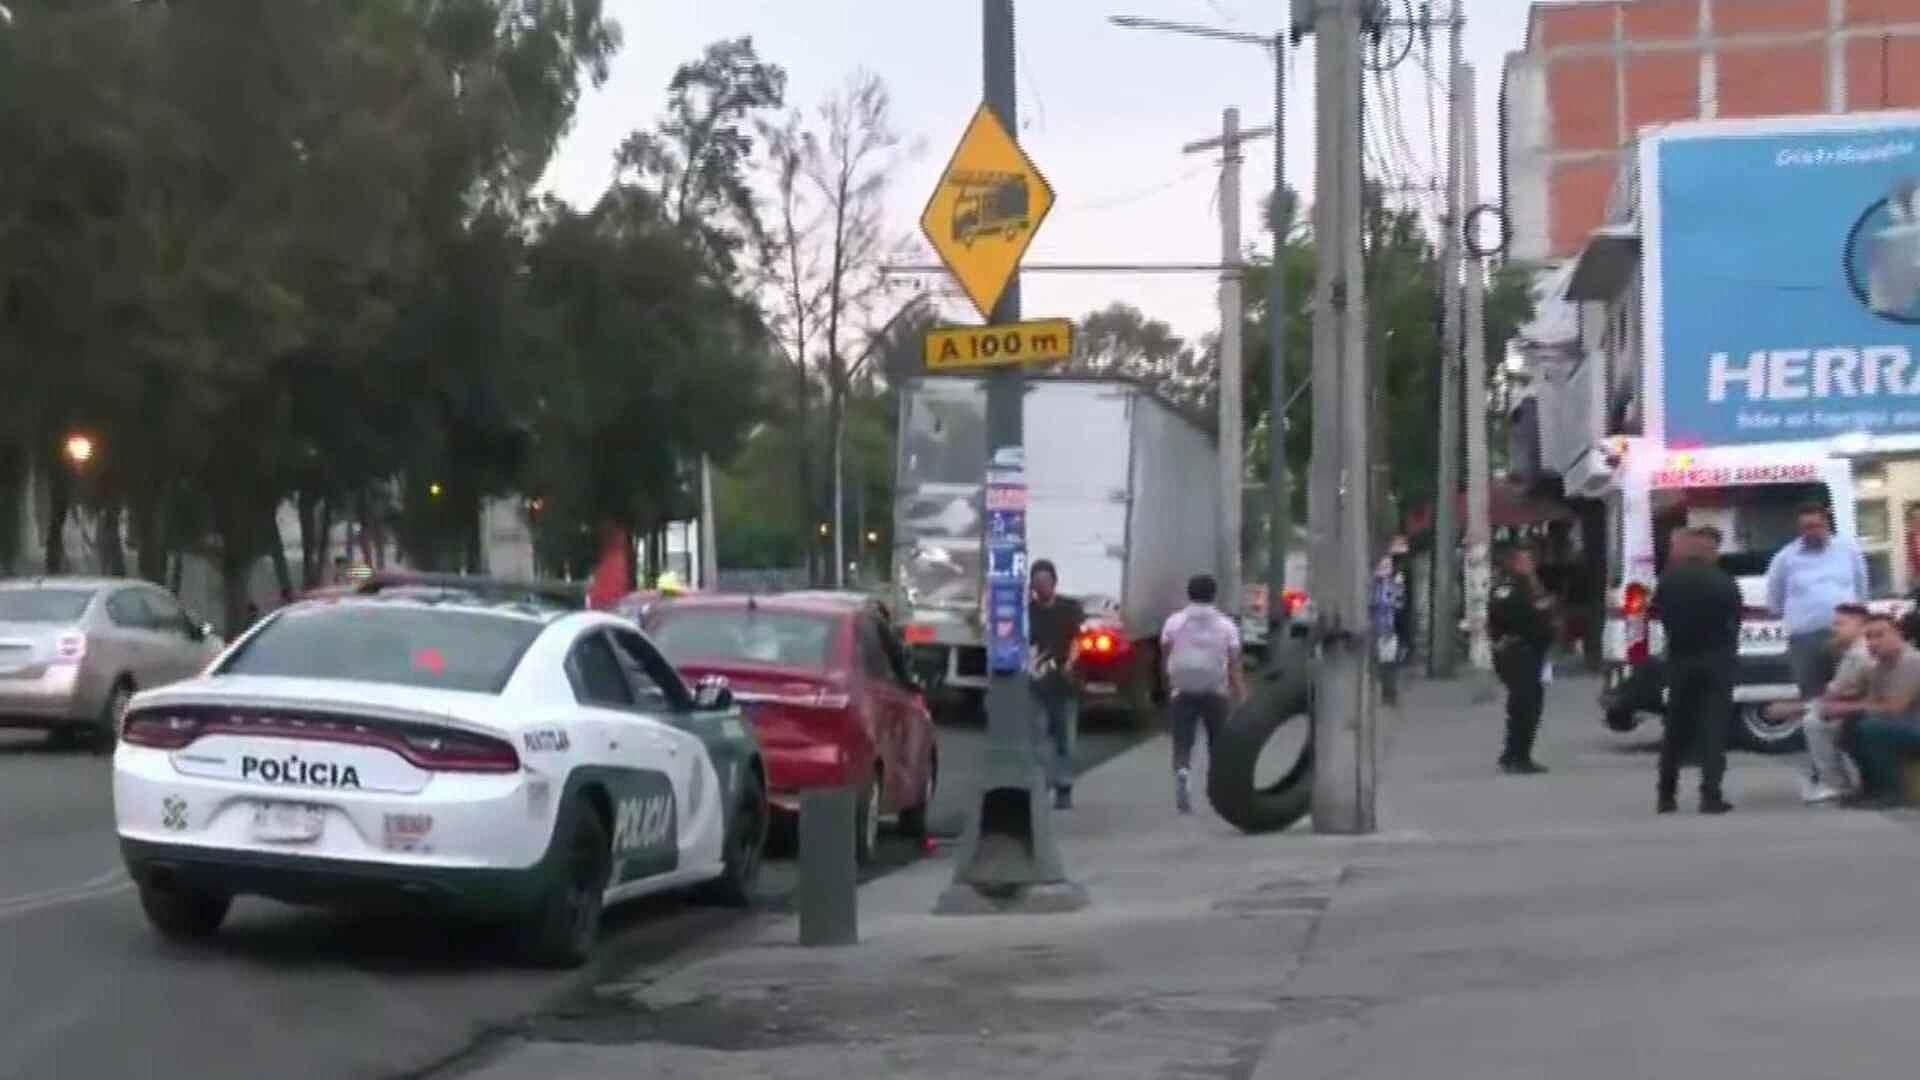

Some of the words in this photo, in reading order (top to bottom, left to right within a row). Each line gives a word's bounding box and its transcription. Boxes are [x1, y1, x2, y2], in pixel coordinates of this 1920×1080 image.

[939, 337, 960, 363] A
[971, 331, 1021, 359] 100
[1031, 333, 1057, 352] m
[241, 755, 361, 789] POLICIA
[612, 794, 673, 852] POLICIA
